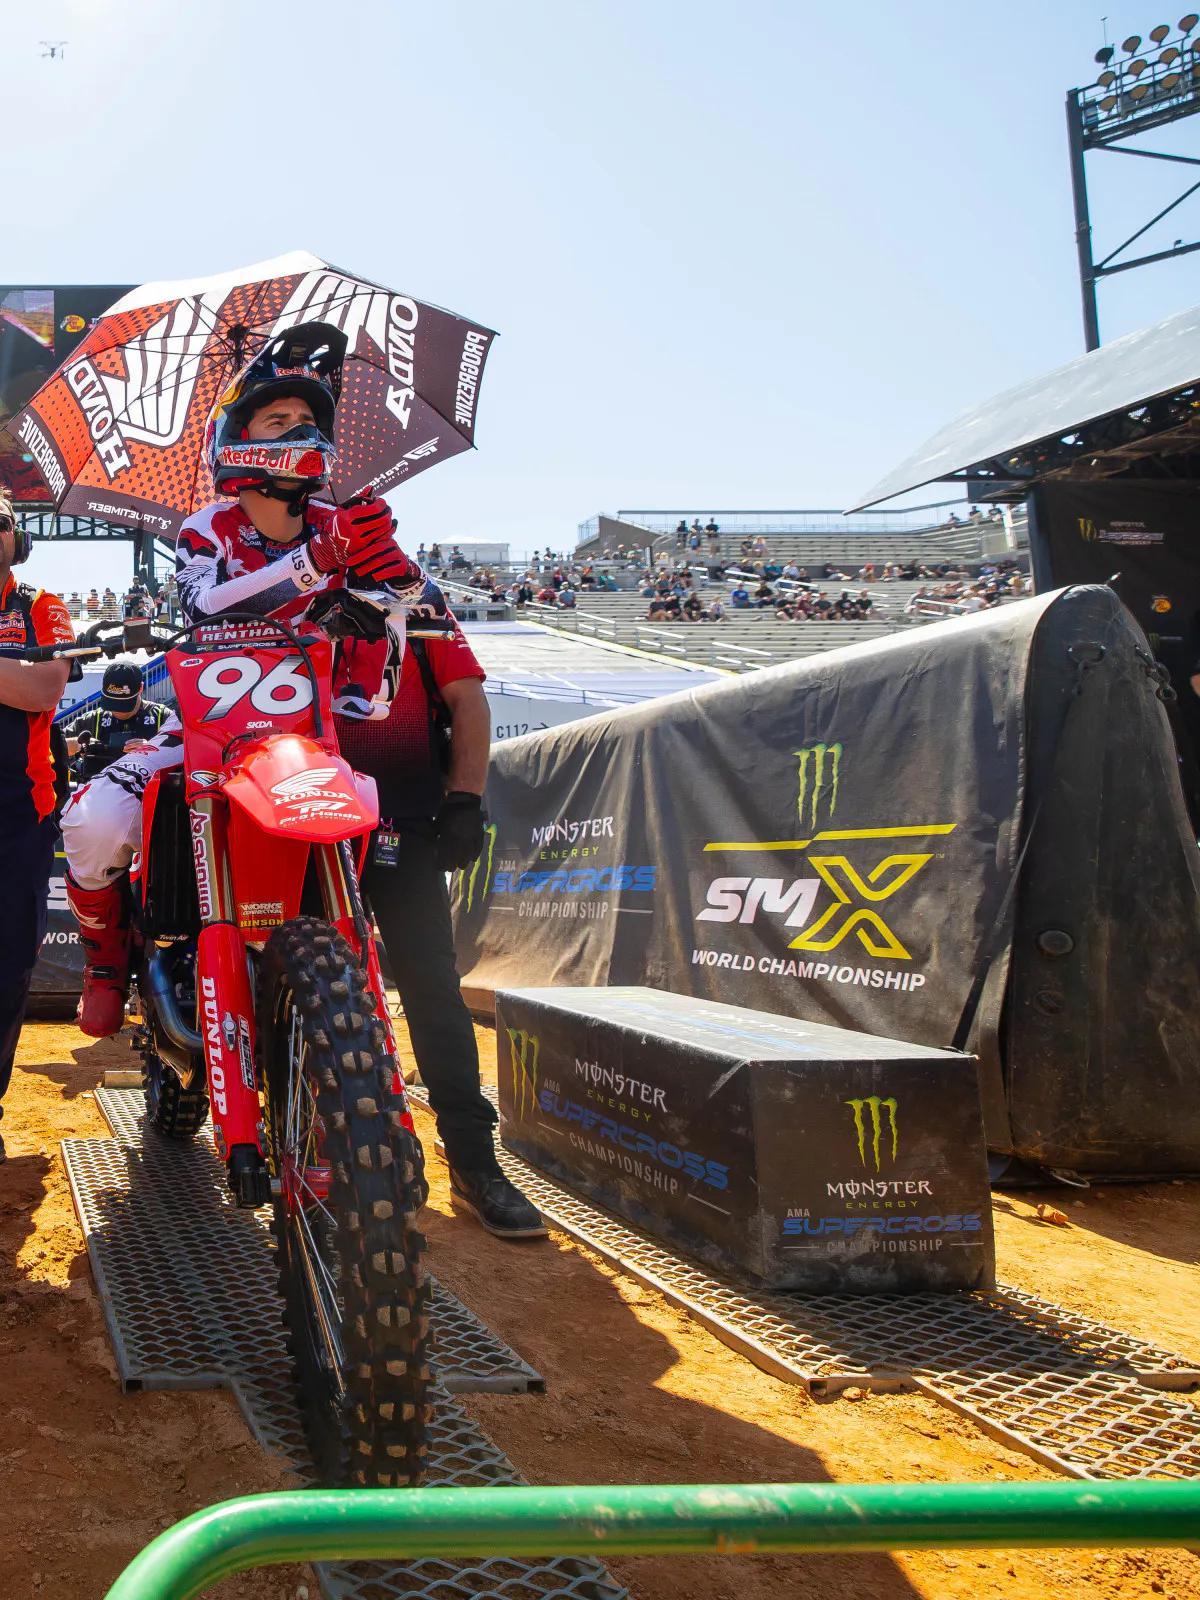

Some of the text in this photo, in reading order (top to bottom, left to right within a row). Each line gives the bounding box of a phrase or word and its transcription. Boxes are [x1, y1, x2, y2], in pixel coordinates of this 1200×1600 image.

[275, 366, 299, 376] Red
[222, 445, 254, 466] Red
[256, 447, 293, 470] Bull
[0, 632, 23, 640] KTM
[197, 654, 317, 724] 96
[246, 720, 273, 729] SKDA
[497, 724, 529, 740] C112
[273, 790, 354, 806] HONDA
[279, 810, 362, 825] Pro Honda
[531, 815, 615, 847] MONSTER
[388, 836, 399, 847] L3
[540, 846, 599, 860] ENERGY
[499, 860, 516, 872] AMA
[491, 864, 657, 894] SUPERCROSS
[239, 902, 285, 911] WORKS
[518, 901, 609, 920] CHAMPIONSHIP
[696, 852, 934, 961] SMX
[240, 919, 284, 928] HINSON
[42, 932, 82, 945] WOR
[159, 934, 189, 942] Twin Air
[692, 948, 927, 993] WORLD CHAMPIONSHIP
[202, 975, 227, 1116] DUNLOP
[543, 1078, 561, 1094] AMA
[574, 1056, 668, 1114] MONSTER
[586, 1088, 652, 1123] ENERGY
[538, 1089, 731, 1191] SUPERCROSS
[569, 1132, 679, 1196] CHAMPIONSHIP
[826, 1178, 933, 1198] MONSTER
[787, 1208, 811, 1218] AMA
[845, 1201, 920, 1209] ENERGY
[782, 1214, 983, 1236] SUPERCROSS
[826, 1239, 944, 1254] CHAMPIONSHIP
